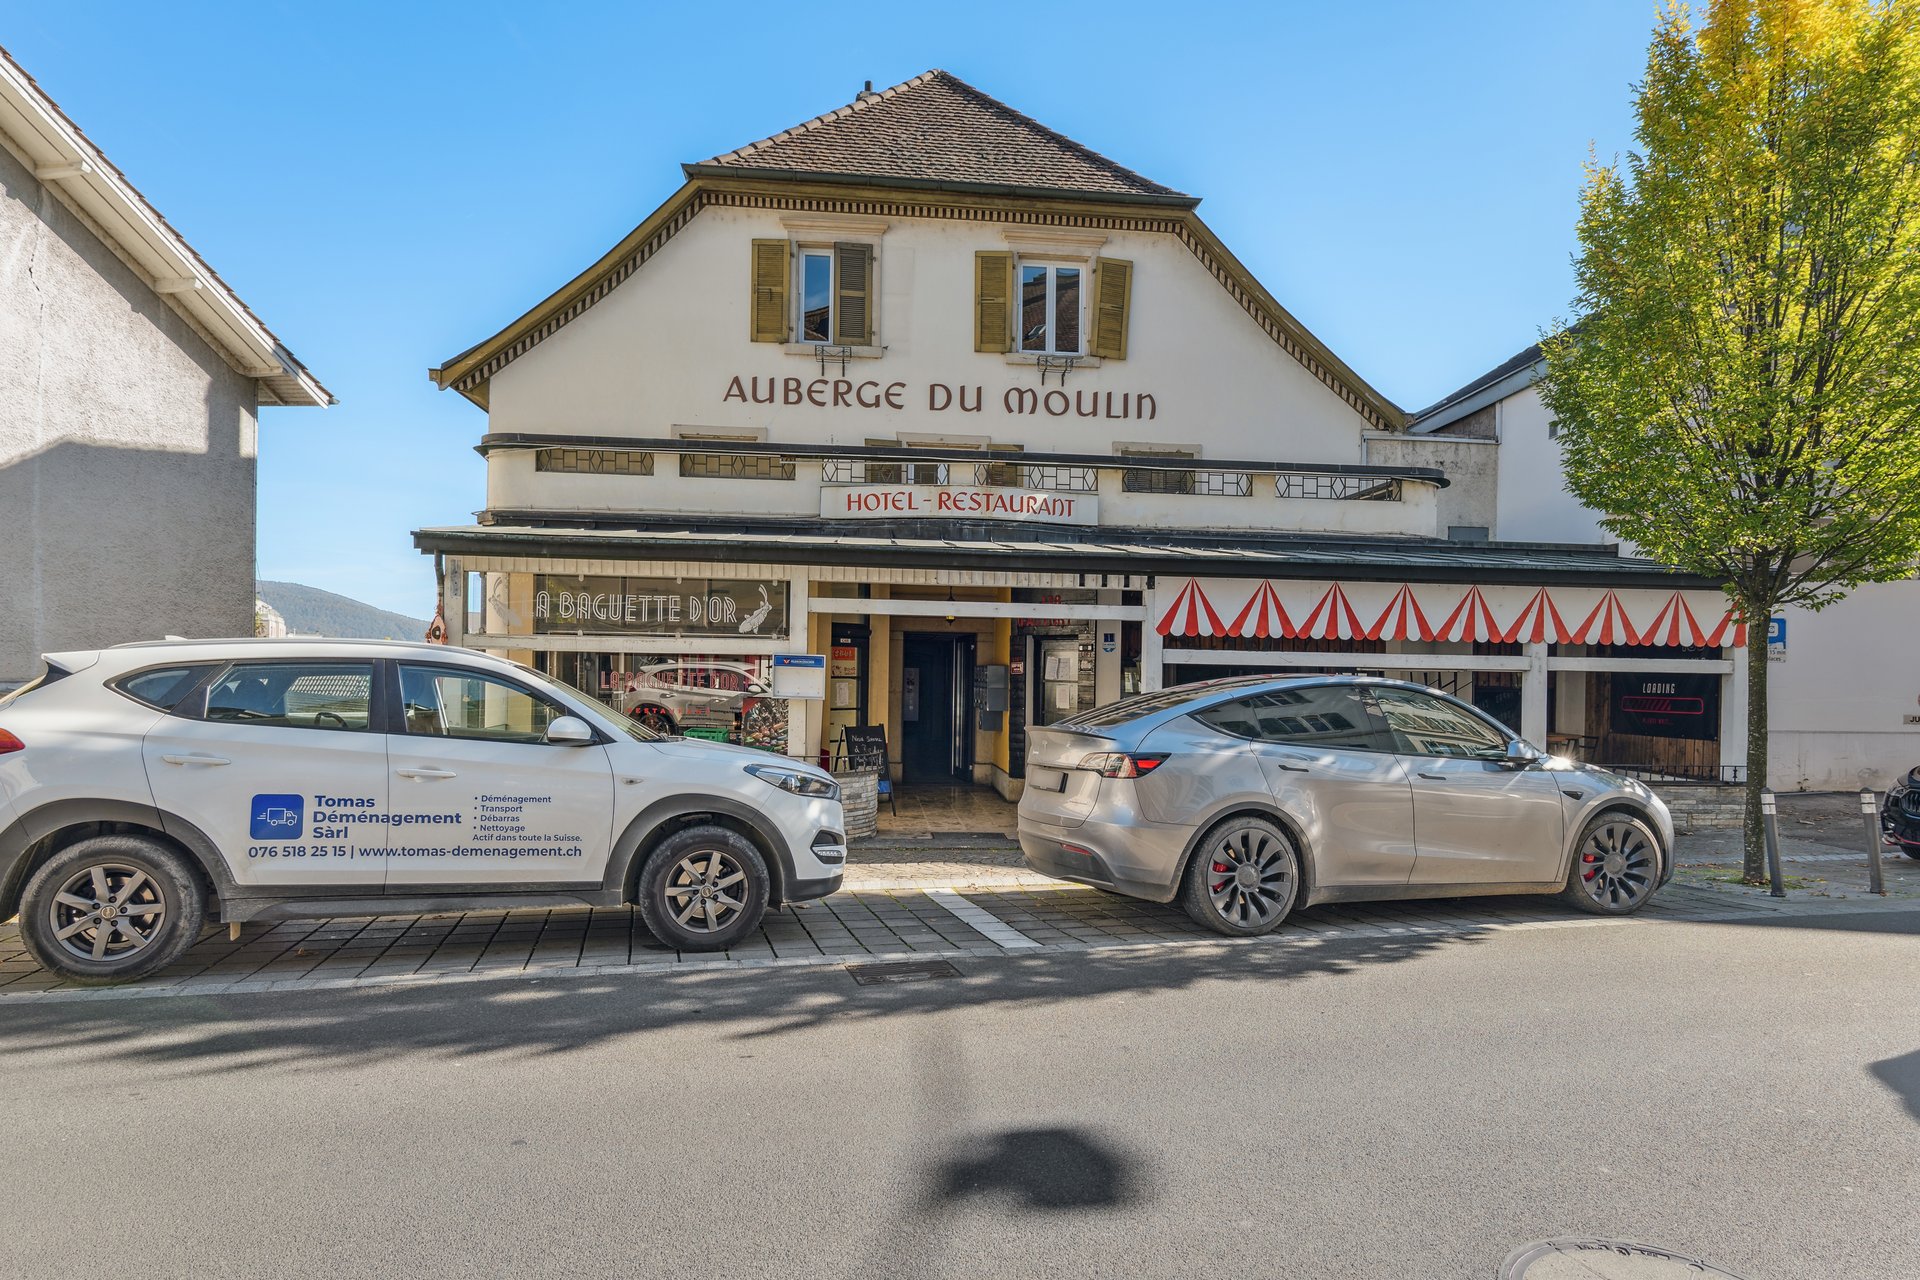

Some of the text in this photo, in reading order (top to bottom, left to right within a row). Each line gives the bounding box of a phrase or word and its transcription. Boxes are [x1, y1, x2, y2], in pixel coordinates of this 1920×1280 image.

[723, 375, 1158, 420] AUBERGE DU MOULIN
[847, 491, 919, 512] HOTEL
[938, 491, 1075, 517] RESTAURANT
[559, 592, 681, 622] BAGUETTE
[689, 596, 738, 623] D'OR
[601, 670, 619, 689] LA
[1642, 683, 1675, 694] LOADING
[314, 794, 376, 808] Tomas
[481, 795, 552, 804] Déménagement
[480, 804, 523, 813] Transport
[312, 809, 462, 827] Déménagement
[480, 814, 520, 822] Débarras
[312, 824, 349, 839] Sàrl
[480, 824, 526, 833] Nettoyage
[519, 834, 542, 842] toute
[553, 834, 583, 842] Suisse.
[248, 846, 278, 858] 076
[282, 846, 307, 858] 518
[311, 846, 329, 858] 25
[332, 846, 346, 858] 15
[359, 845, 582, 860] www.tomas-demenagement.ch
